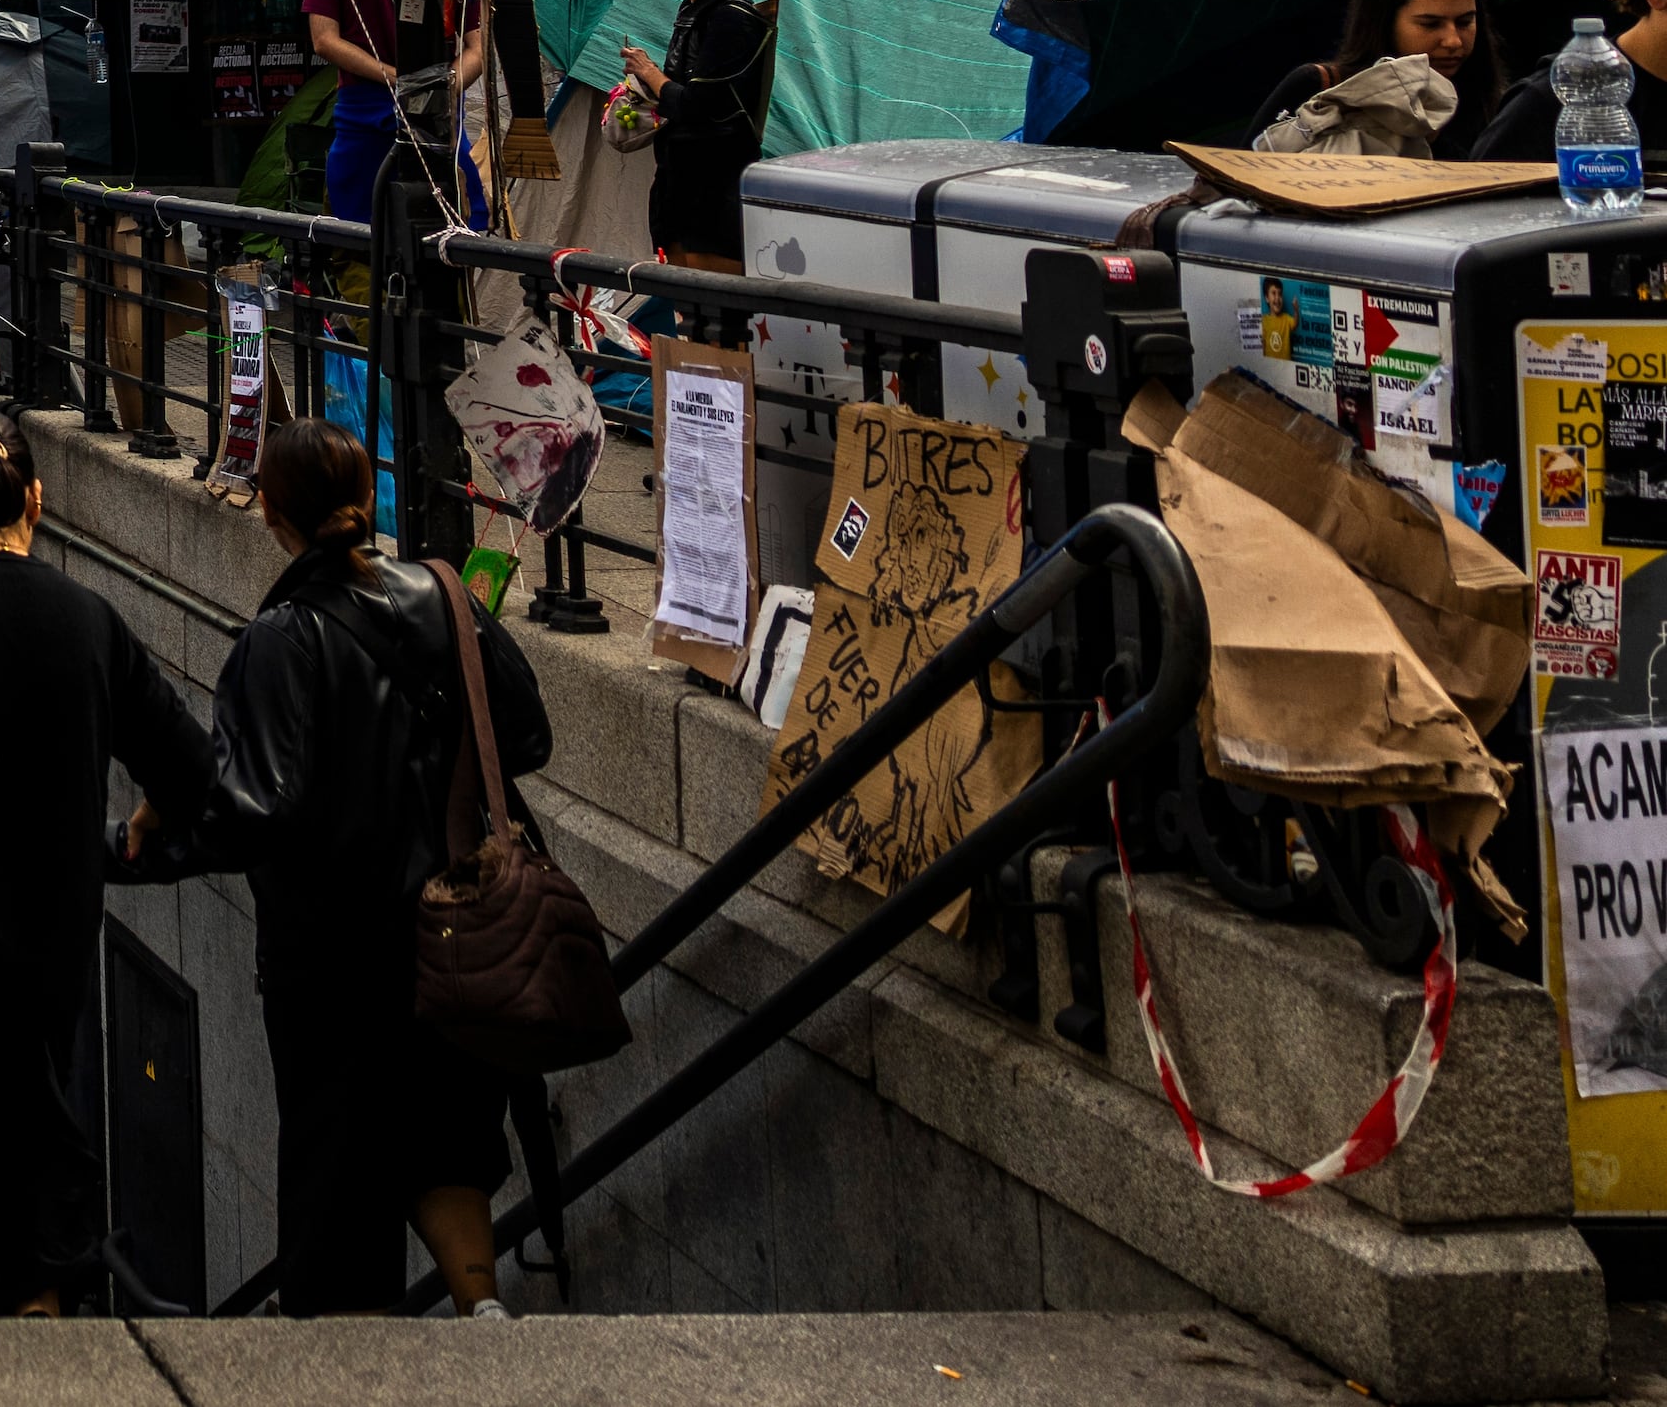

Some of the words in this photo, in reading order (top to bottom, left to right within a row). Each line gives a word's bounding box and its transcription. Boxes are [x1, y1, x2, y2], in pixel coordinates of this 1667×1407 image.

[219, 44, 246, 55] RECLAMA
[267, 43, 297, 54] RECLAMA
[213, 55, 252, 69] NOCTURNA
[260, 53, 304, 67] NOCTURNA
[1578, 163, 1626, 173] Primavera
[1367, 295, 1434, 317] EXTREMADURA
[1370, 354, 1387, 367] CON
[677, 401, 702, 417] PARLAMENTO
[707, 407, 716, 421] SUS
[718, 409, 734, 423] LEYES
[1380, 411, 1437, 435] ISRAEL
[1540, 555, 1615, 587] ANTI
[1539, 624, 1614, 642] FASCISTAS
[824, 603, 880, 723] FUER
[805, 675, 841, 731] DE
[1573, 860, 1642, 941] PRO
